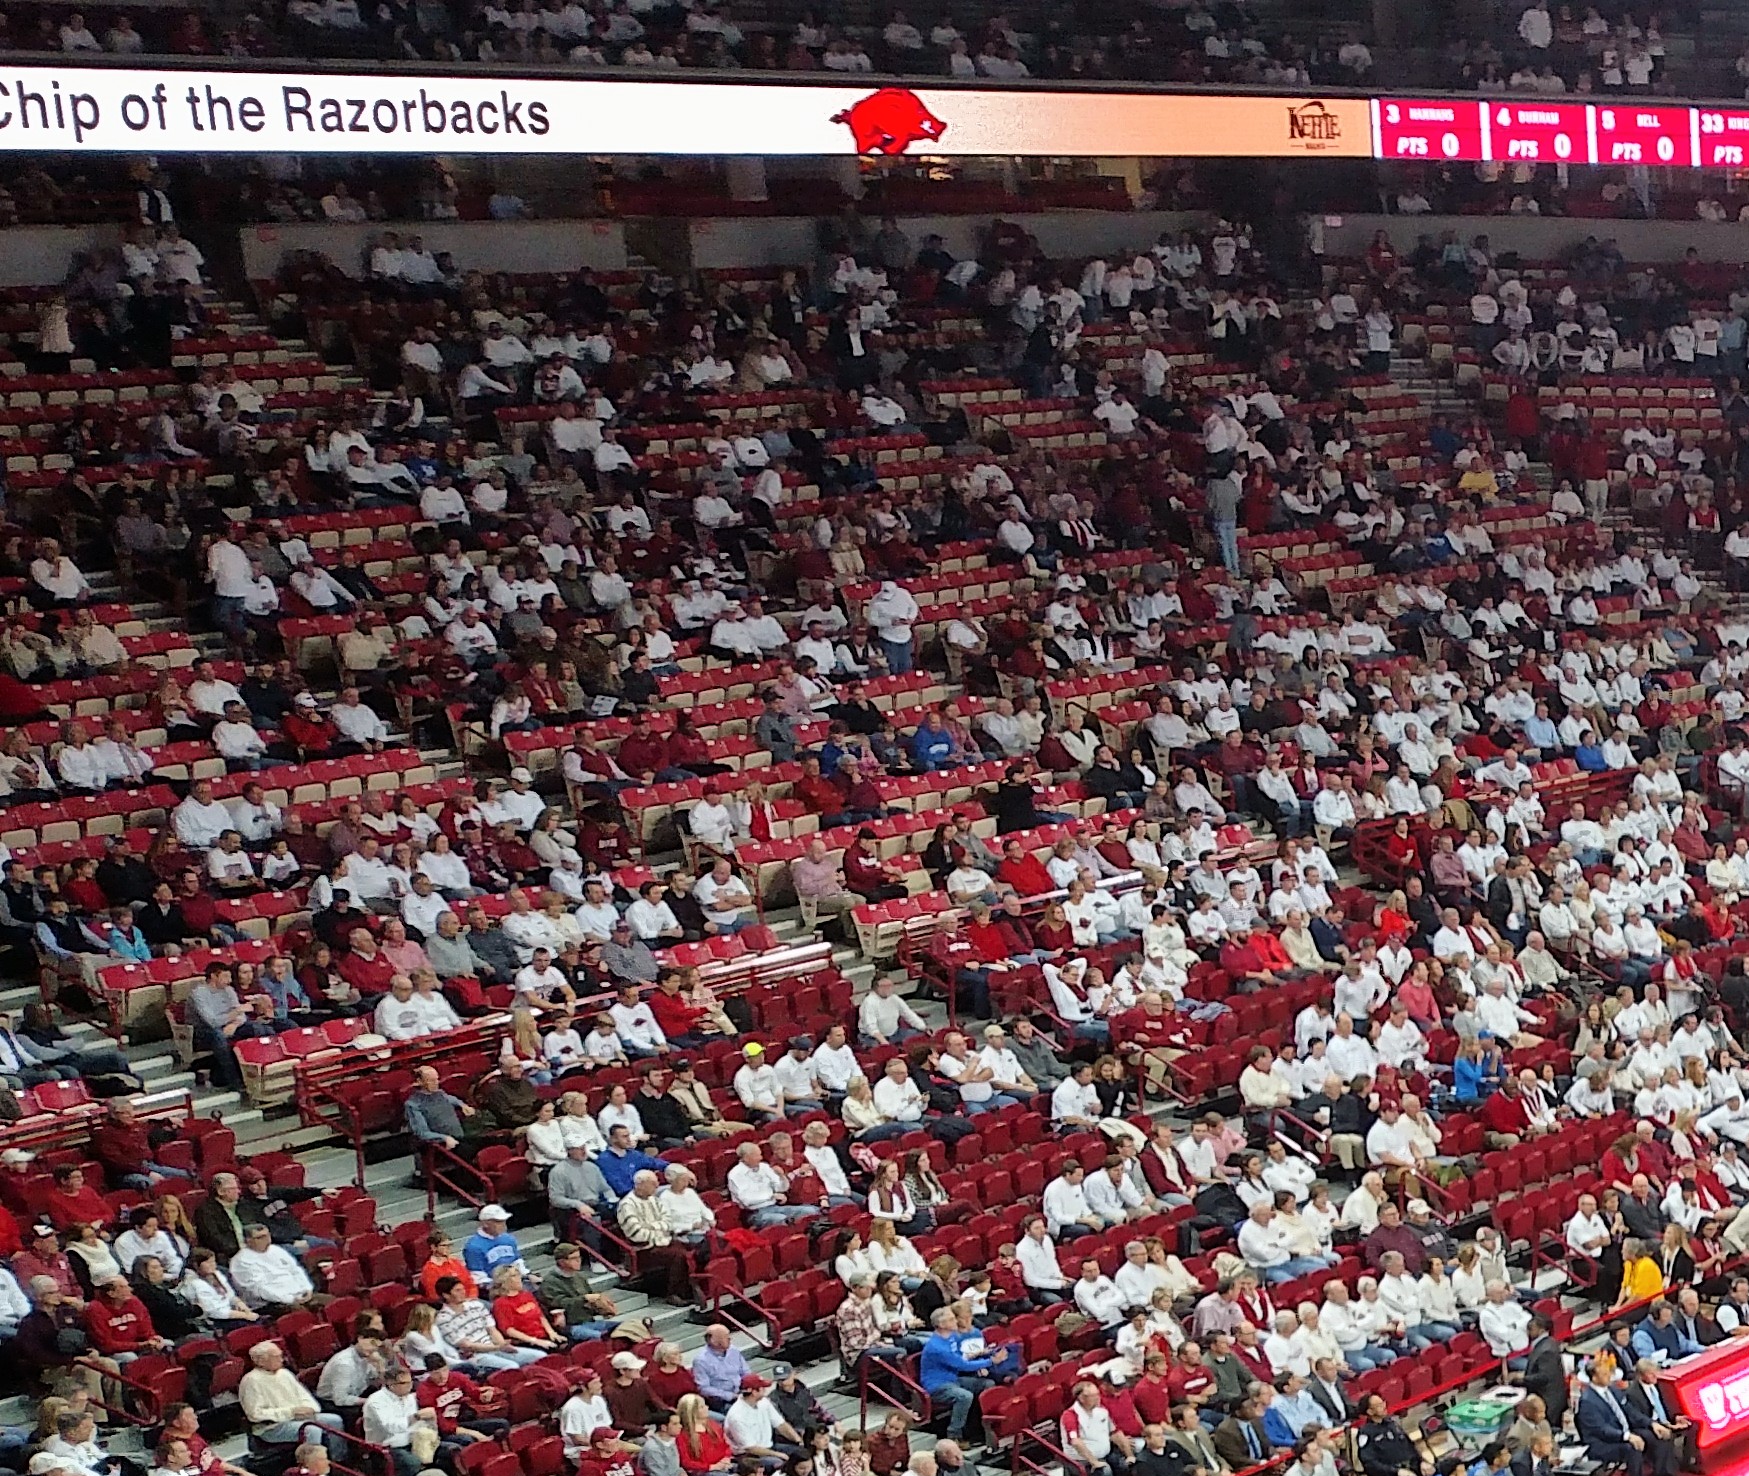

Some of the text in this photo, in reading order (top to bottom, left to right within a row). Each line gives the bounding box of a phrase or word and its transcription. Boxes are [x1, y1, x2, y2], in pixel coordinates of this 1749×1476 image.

[121, 84, 167, 132] of
[186, 86, 266, 133] the
[282, 86, 550, 136] Razorbacks
[1386, 104, 1401, 124] 3
[1497, 108, 1512, 126] 4
[1602, 110, 1616, 130] 5
[1701, 113, 1725, 134] 33
[1397, 133, 1460, 157] PTS 0
[1508, 134, 1572, 158] PTS 0
[1612, 137, 1674, 161] PTS 0
[1714, 145, 1743, 164] PTS
